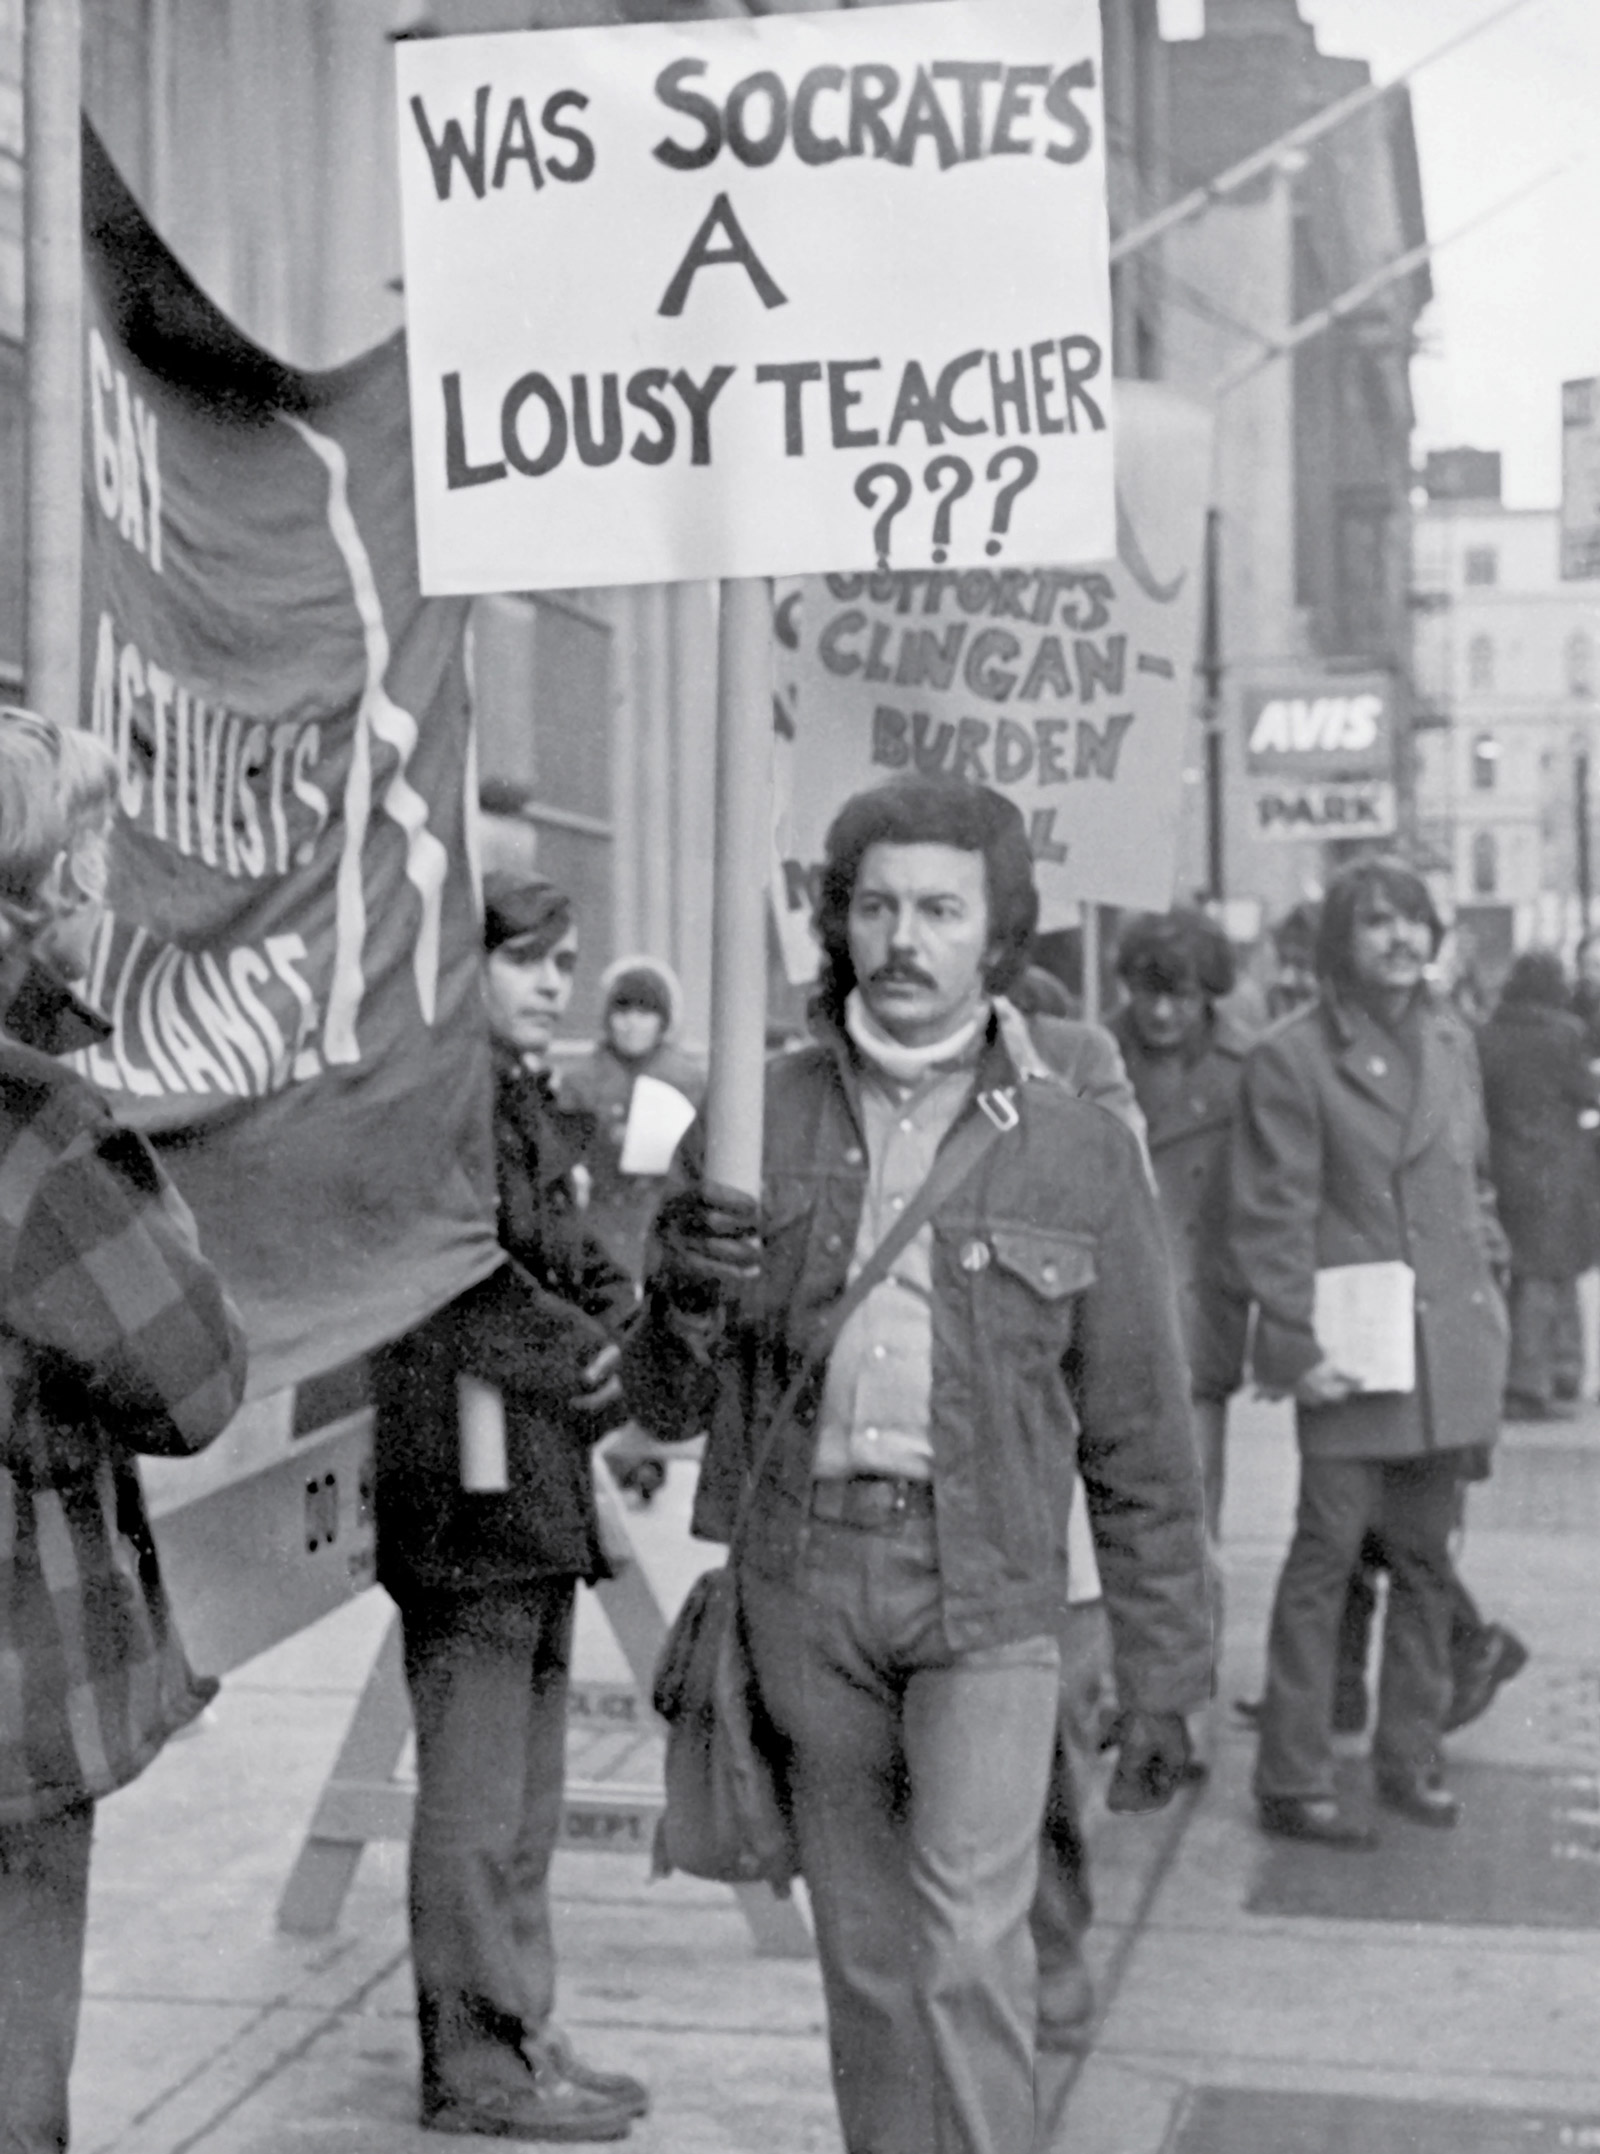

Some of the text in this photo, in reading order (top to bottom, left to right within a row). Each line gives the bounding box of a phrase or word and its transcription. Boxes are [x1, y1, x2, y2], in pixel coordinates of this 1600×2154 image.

[411, 57, 1095, 201] WAS SOCRATES
[658, 191, 789, 317] A
[90, 328, 162, 574] GAY
[441, 334, 1106, 491] LOUSY TEACHER
[854, 446, 1039, 571] ???
[872, 704, 1134, 786] BURDEN
[1250, 694, 1383, 754] AVIS
[75, 908, 323, 1098] LLIANCE
